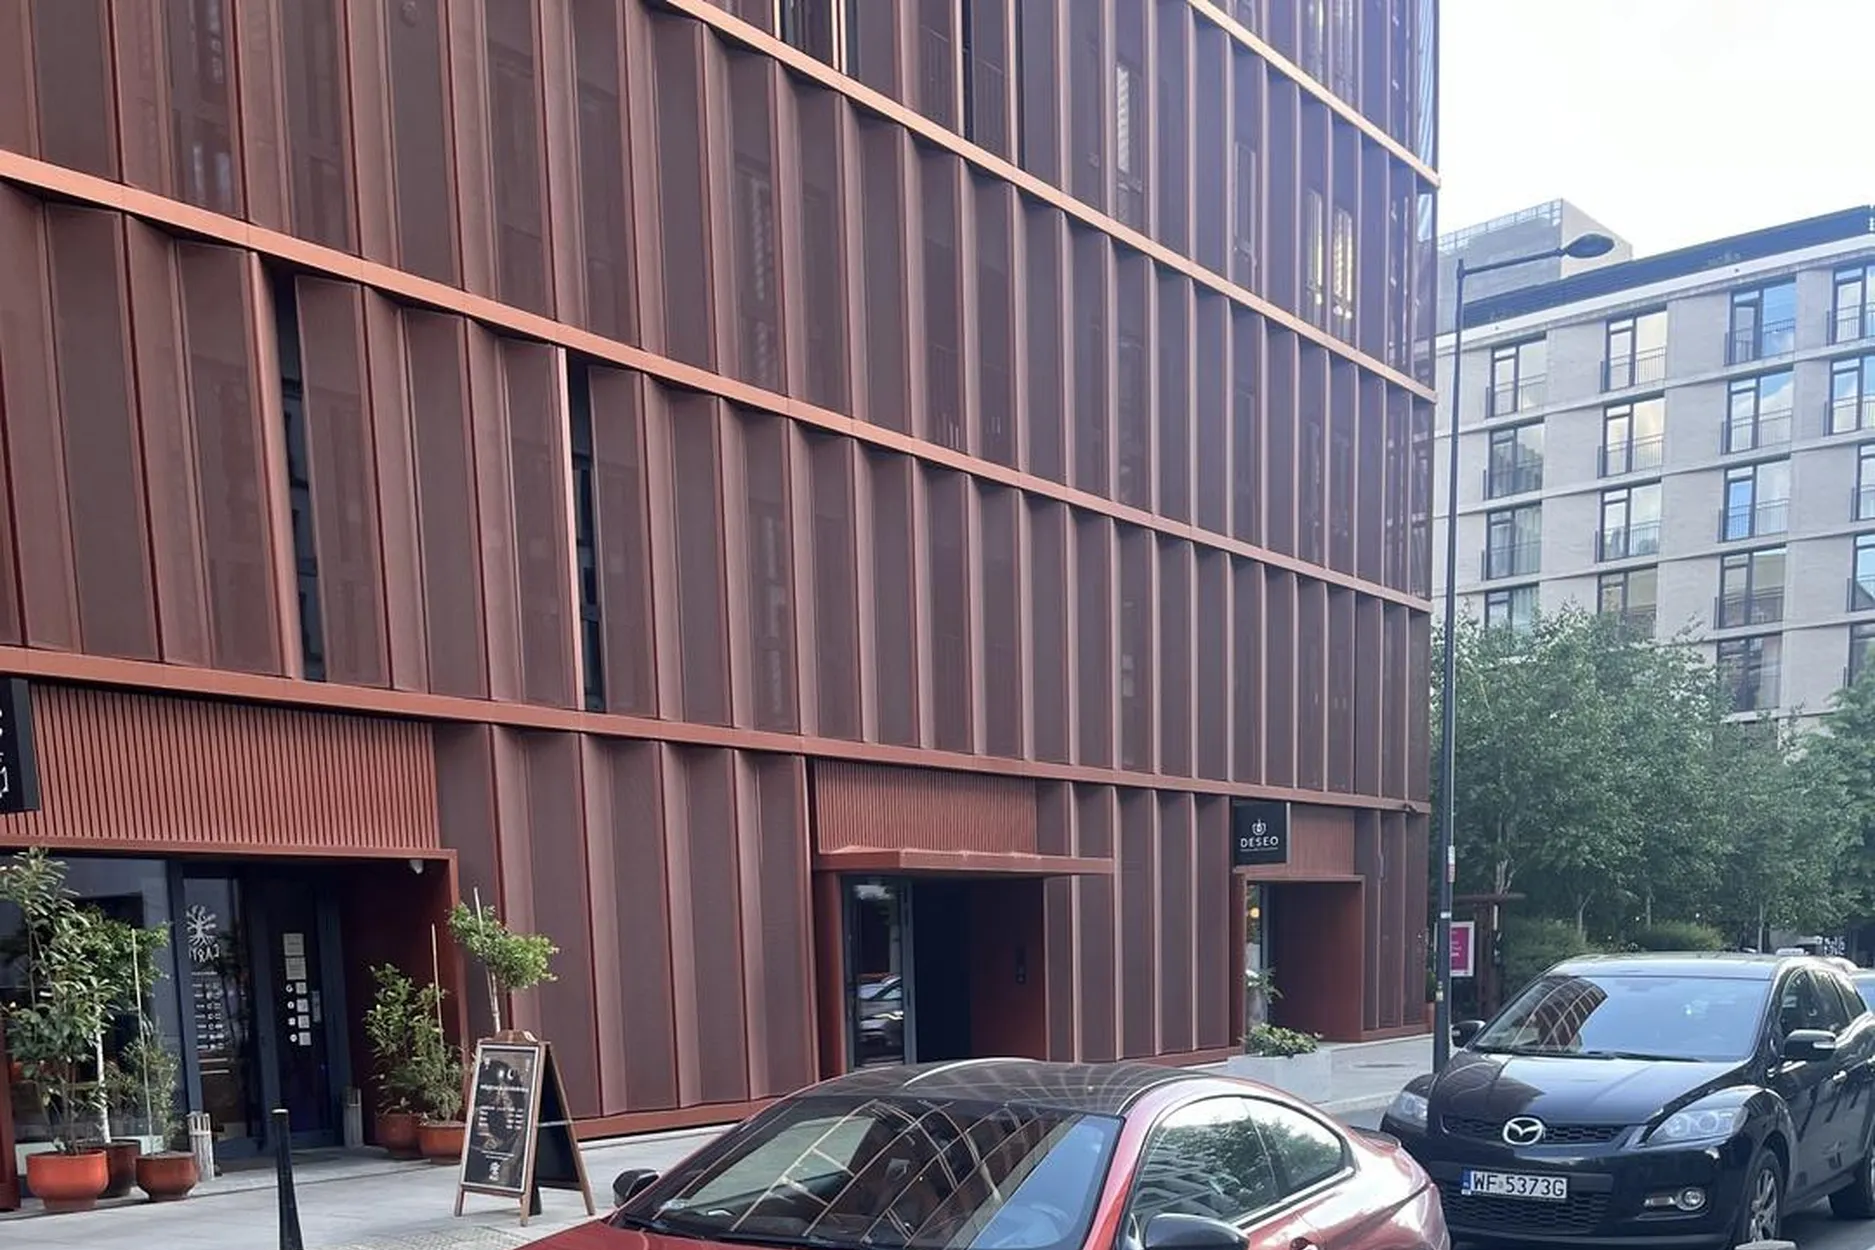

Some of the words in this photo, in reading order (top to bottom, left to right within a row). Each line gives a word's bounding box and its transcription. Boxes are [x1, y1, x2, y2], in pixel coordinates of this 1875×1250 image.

[1240, 836, 1279, 848] DESEO
[1473, 1173, 1498, 1191] WF
[1506, 1176, 1565, 1197] 5373G
